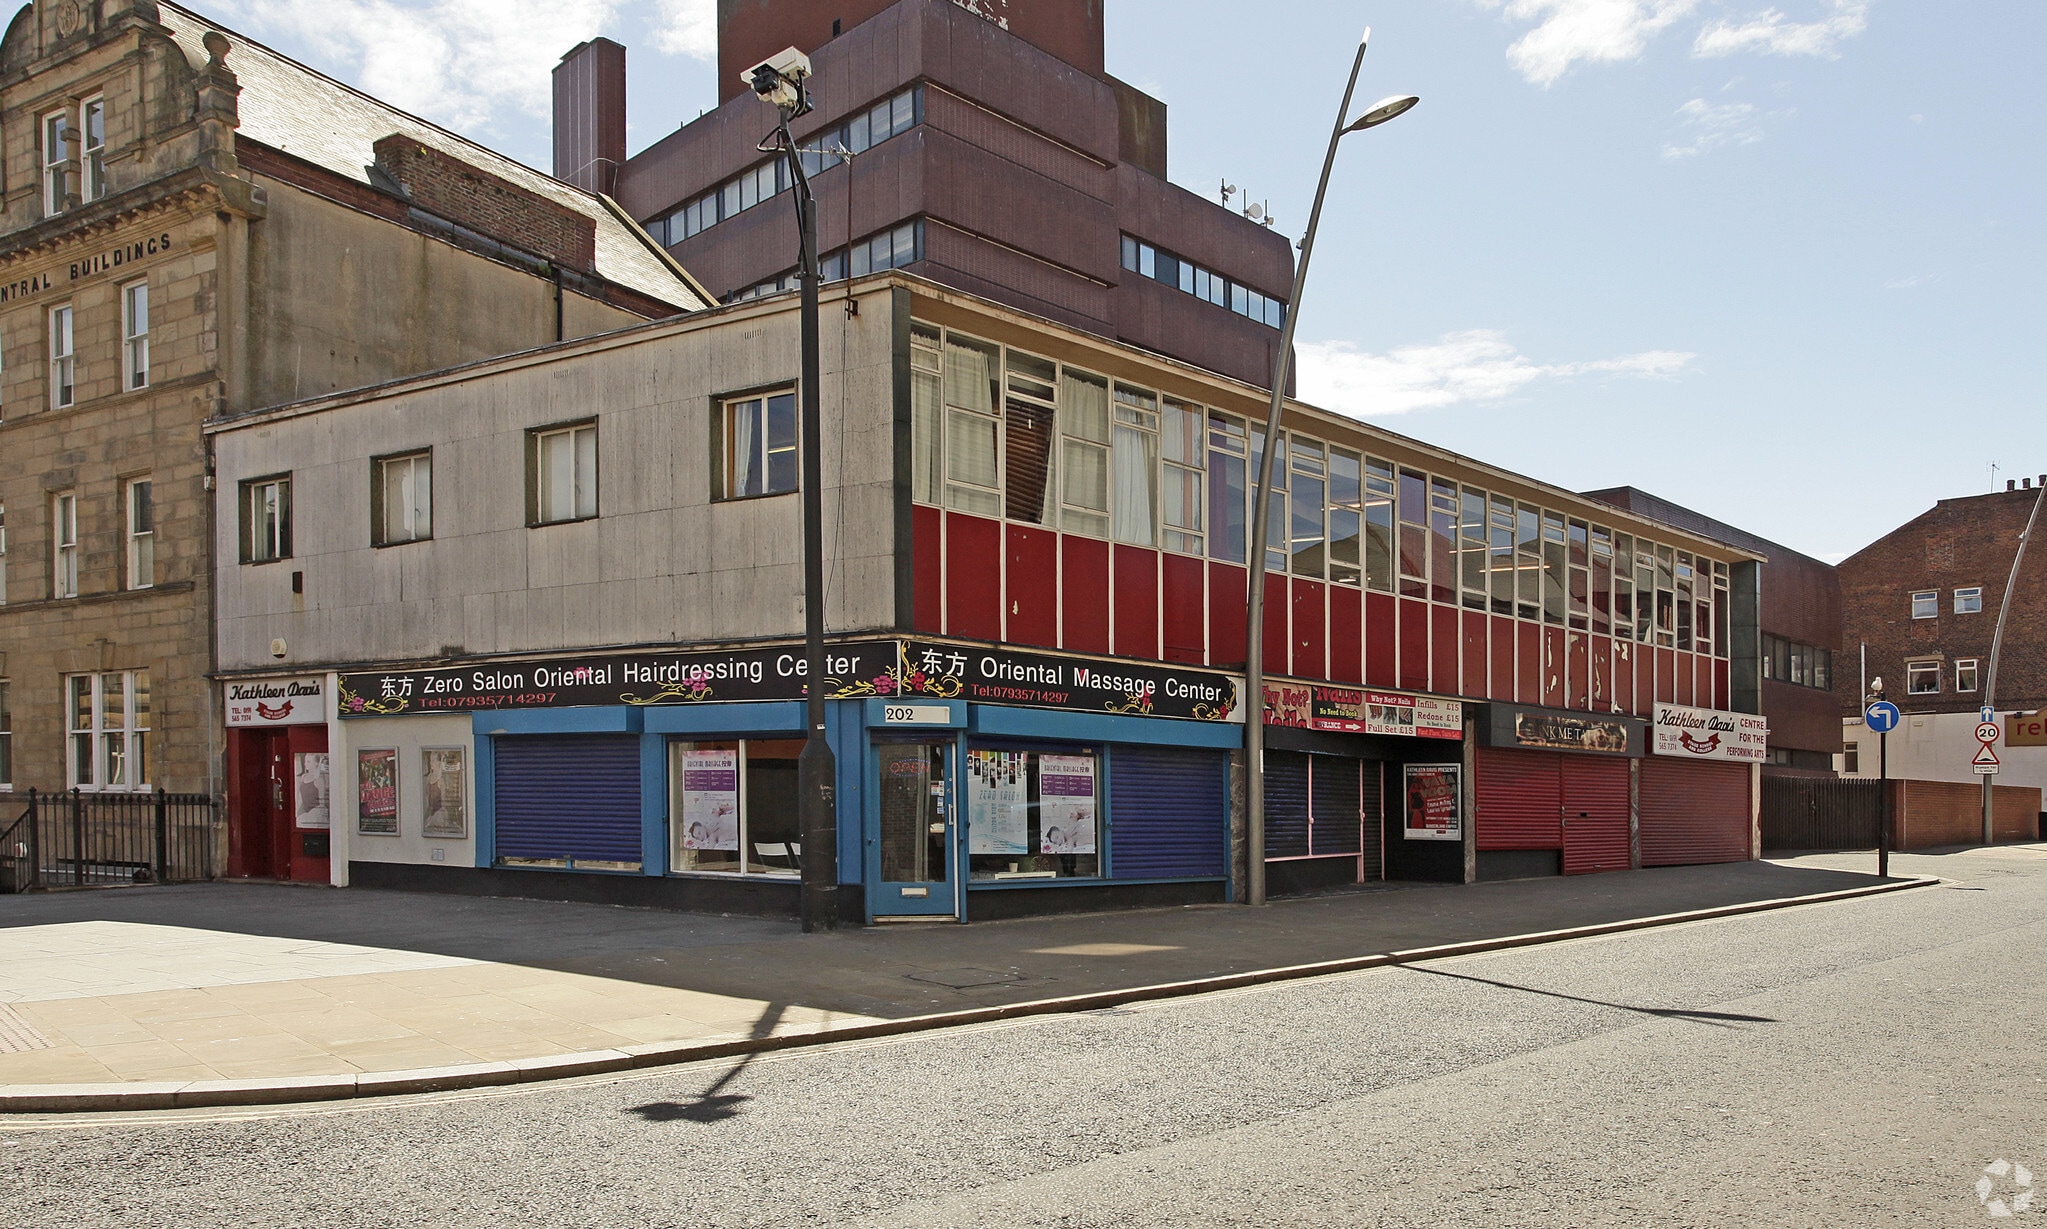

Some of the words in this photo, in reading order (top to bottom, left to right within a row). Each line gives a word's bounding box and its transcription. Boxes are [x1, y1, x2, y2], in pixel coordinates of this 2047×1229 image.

[70, 233, 171, 281] BUILDINGS
[380, 675, 414, 697] 东方
[424, 675, 463, 694] Zero
[472, 671, 524, 692] Salon
[534, 664, 612, 689] Oriental
[624, 656, 763, 683] Hairdressing
[776, 653, 860, 677] Ceter
[921, 648, 967, 677] 东方
[981, 656, 1062, 684] Oriental
[1073, 668, 1156, 698] Massage
[1165, 678, 1222, 701] Center
[230, 683, 285, 700] Kathleen
[287, 680, 321, 697] Davis
[970, 683, 1069, 704] Tel:07935714297
[418, 692, 557, 709] Tel:07935714297
[1262, 685, 1280, 709] hy
[1282, 687, 1309, 707] Not?
[1370, 695, 1383, 703] Why
[1384, 696, 1397, 704] Not?
[1397, 697, 1411, 705] Nails
[1319, 707, 1327, 715] No
[1417, 700, 1438, 709] Infills
[1446, 703, 1459, 711] £15
[886, 707, 914, 721] 202
[1417, 711, 1444, 721] Redone
[1446, 714, 1459, 723] £15
[1657, 709, 1705, 729] Kathleen
[1707, 715, 1736, 732] Davis
[1367, 723, 1383, 733] Full
[1384, 725, 1397, 733] Set
[1399, 727, 1413, 735] £15
[1740, 718, 1764, 730] CENTRE
[1739, 732, 1752, 743] FOR
[1753, 734, 1764, 744] THE
[1979, 728, 1996, 738] 20
[1726, 746, 1753, 758] PERFORMING
[1754, 748, 1764, 759] ARTS
[889, 761, 930, 773] OPEN
